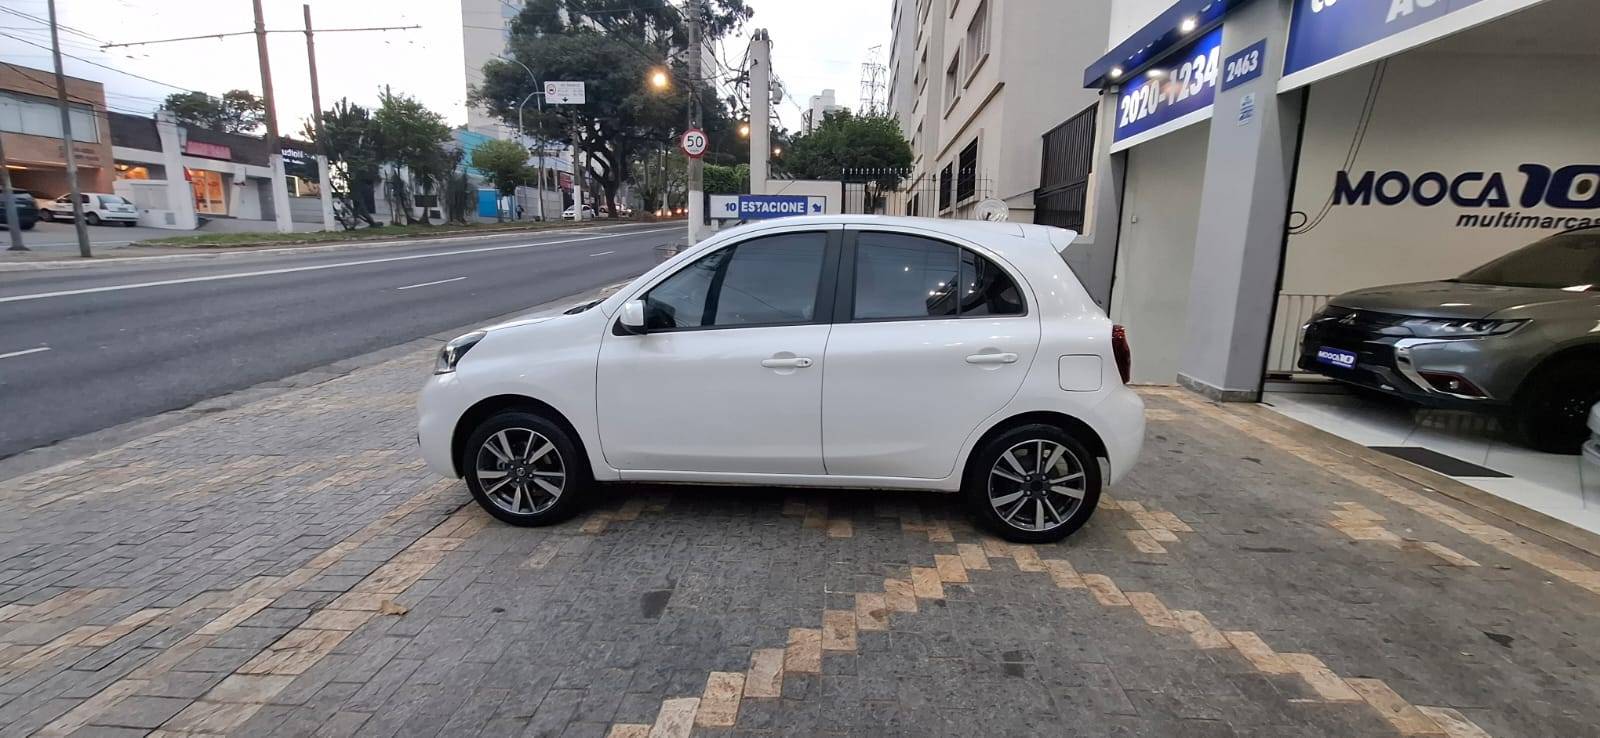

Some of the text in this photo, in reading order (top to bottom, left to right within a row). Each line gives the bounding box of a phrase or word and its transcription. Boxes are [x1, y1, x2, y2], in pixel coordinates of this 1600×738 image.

[1226, 50, 1258, 83] 2463
[1119, 45, 1221, 129] 2020-1234
[687, 135, 704, 148] 50
[1333, 163, 1600, 210] MOOCA 10
[725, 202, 805, 213] 10 ESTACIONE
